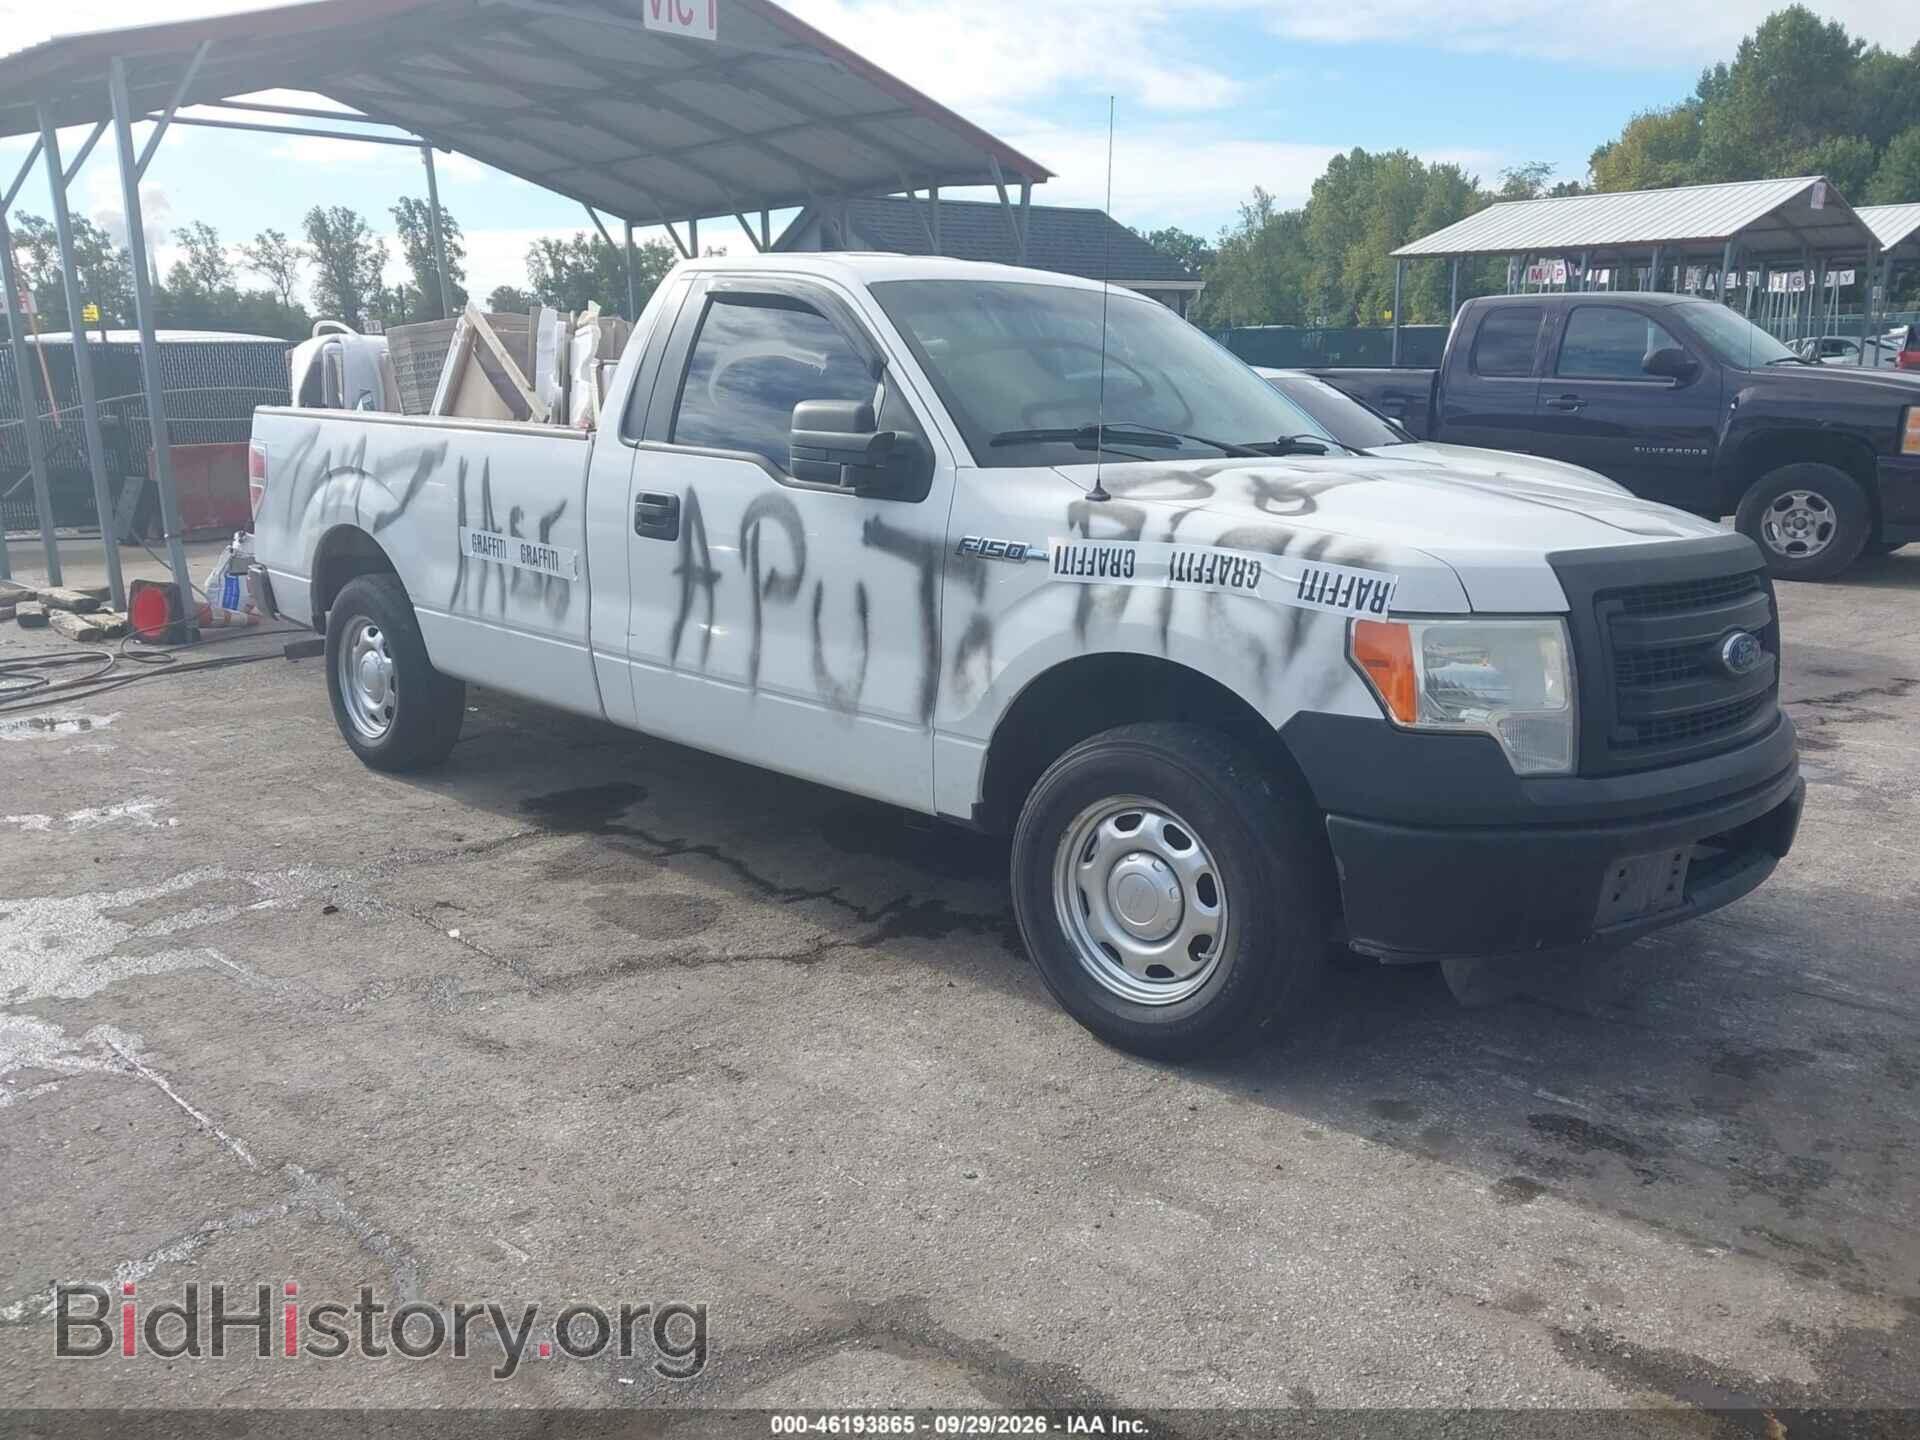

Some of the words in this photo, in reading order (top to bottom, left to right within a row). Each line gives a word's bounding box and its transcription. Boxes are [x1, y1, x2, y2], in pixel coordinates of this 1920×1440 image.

[1531, 268, 1543, 280] M
[1555, 268, 1564, 280] P
[471, 532, 507, 561] GRAFFITI
[520, 543, 560, 573] GRAFFITI
[1053, 545, 1136, 579] GRAFFITI
[1168, 551, 1263, 590] GRAFFITI
[1297, 568, 1396, 614] RAFFITI
